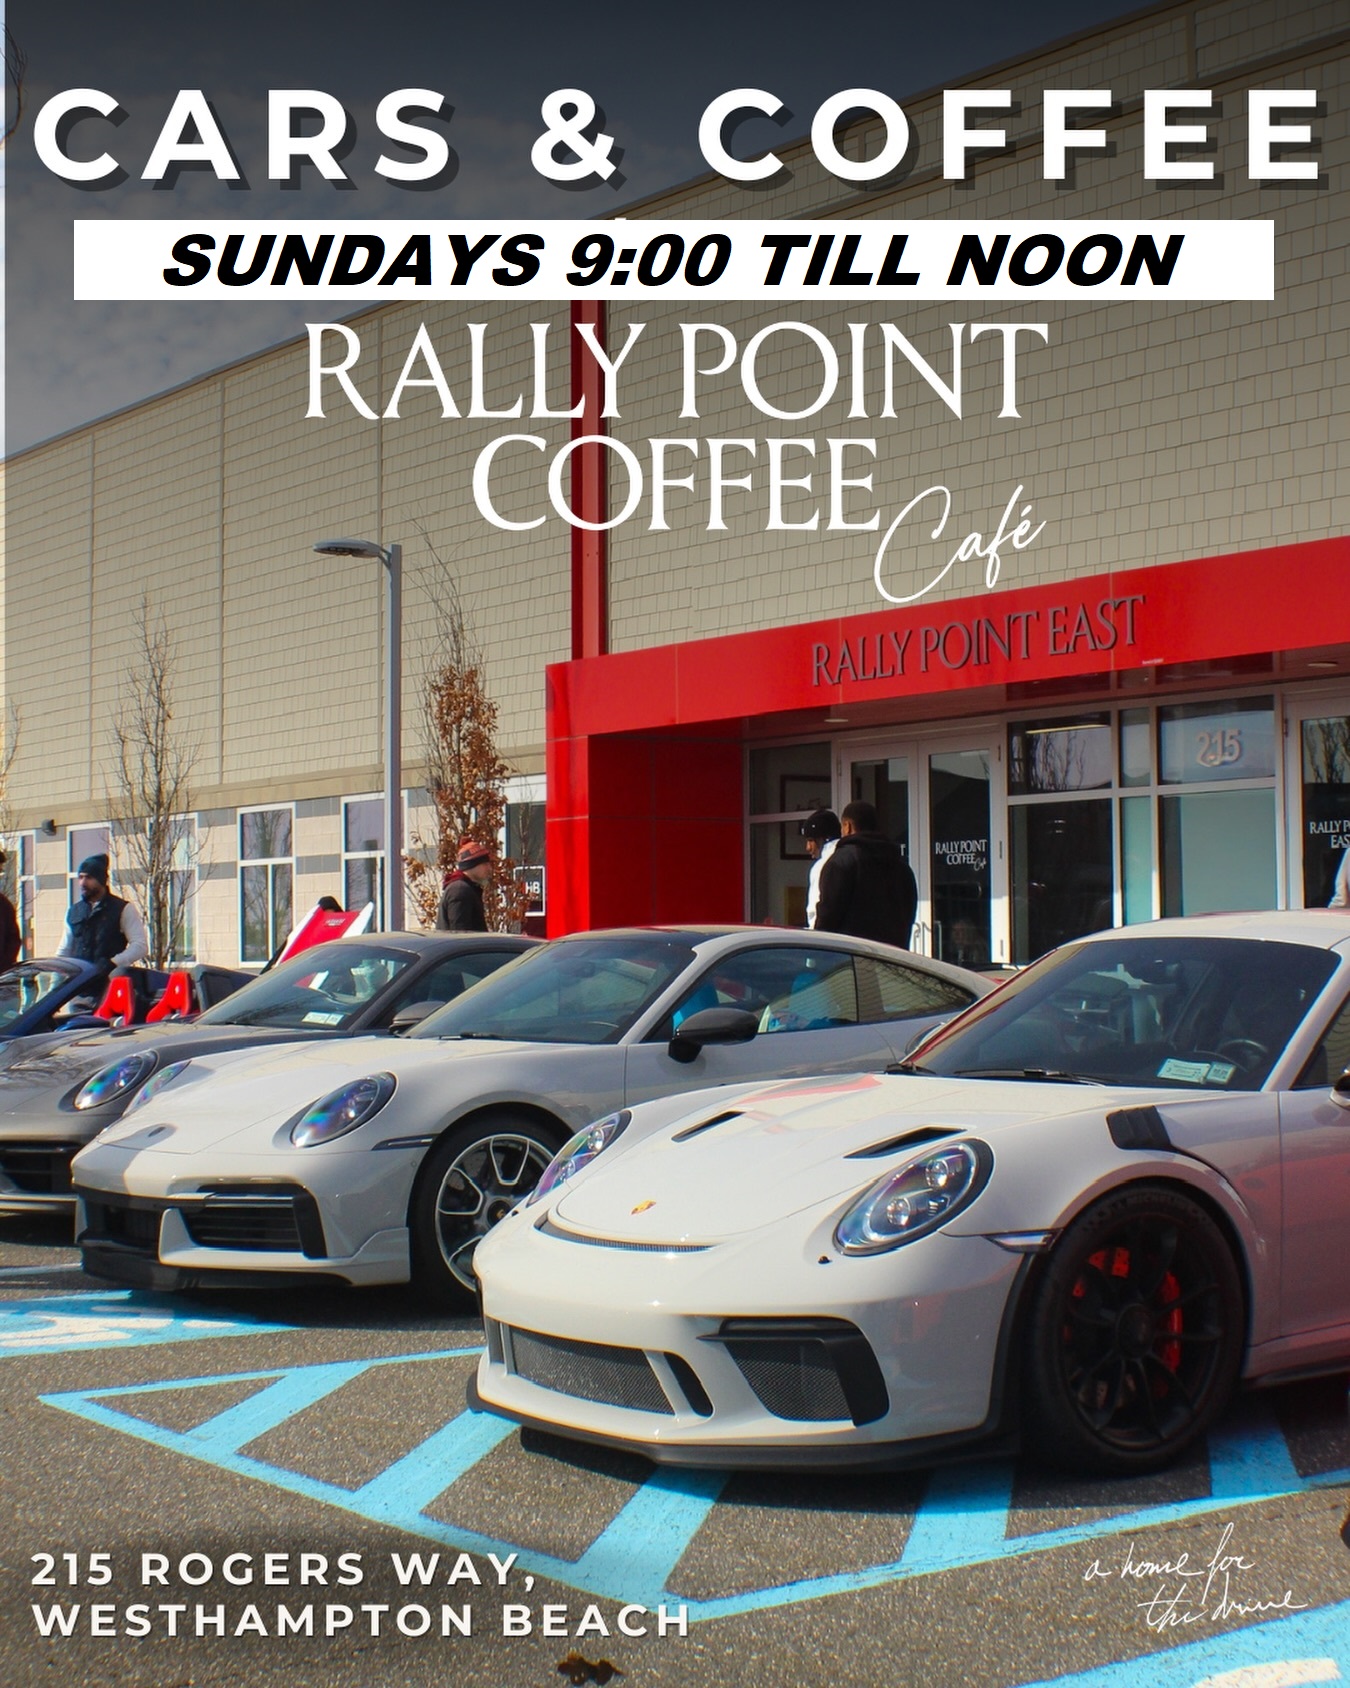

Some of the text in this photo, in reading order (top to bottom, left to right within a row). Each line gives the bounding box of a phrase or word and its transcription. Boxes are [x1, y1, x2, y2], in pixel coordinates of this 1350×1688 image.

[812, 595, 1146, 687] RALLY POINT EAST
[1195, 729, 1242, 767] 215
[1309, 820, 1341, 834] RALLY
[935, 839, 987, 855] RALLY POINT
[946, 853, 977, 865] COFFEE
